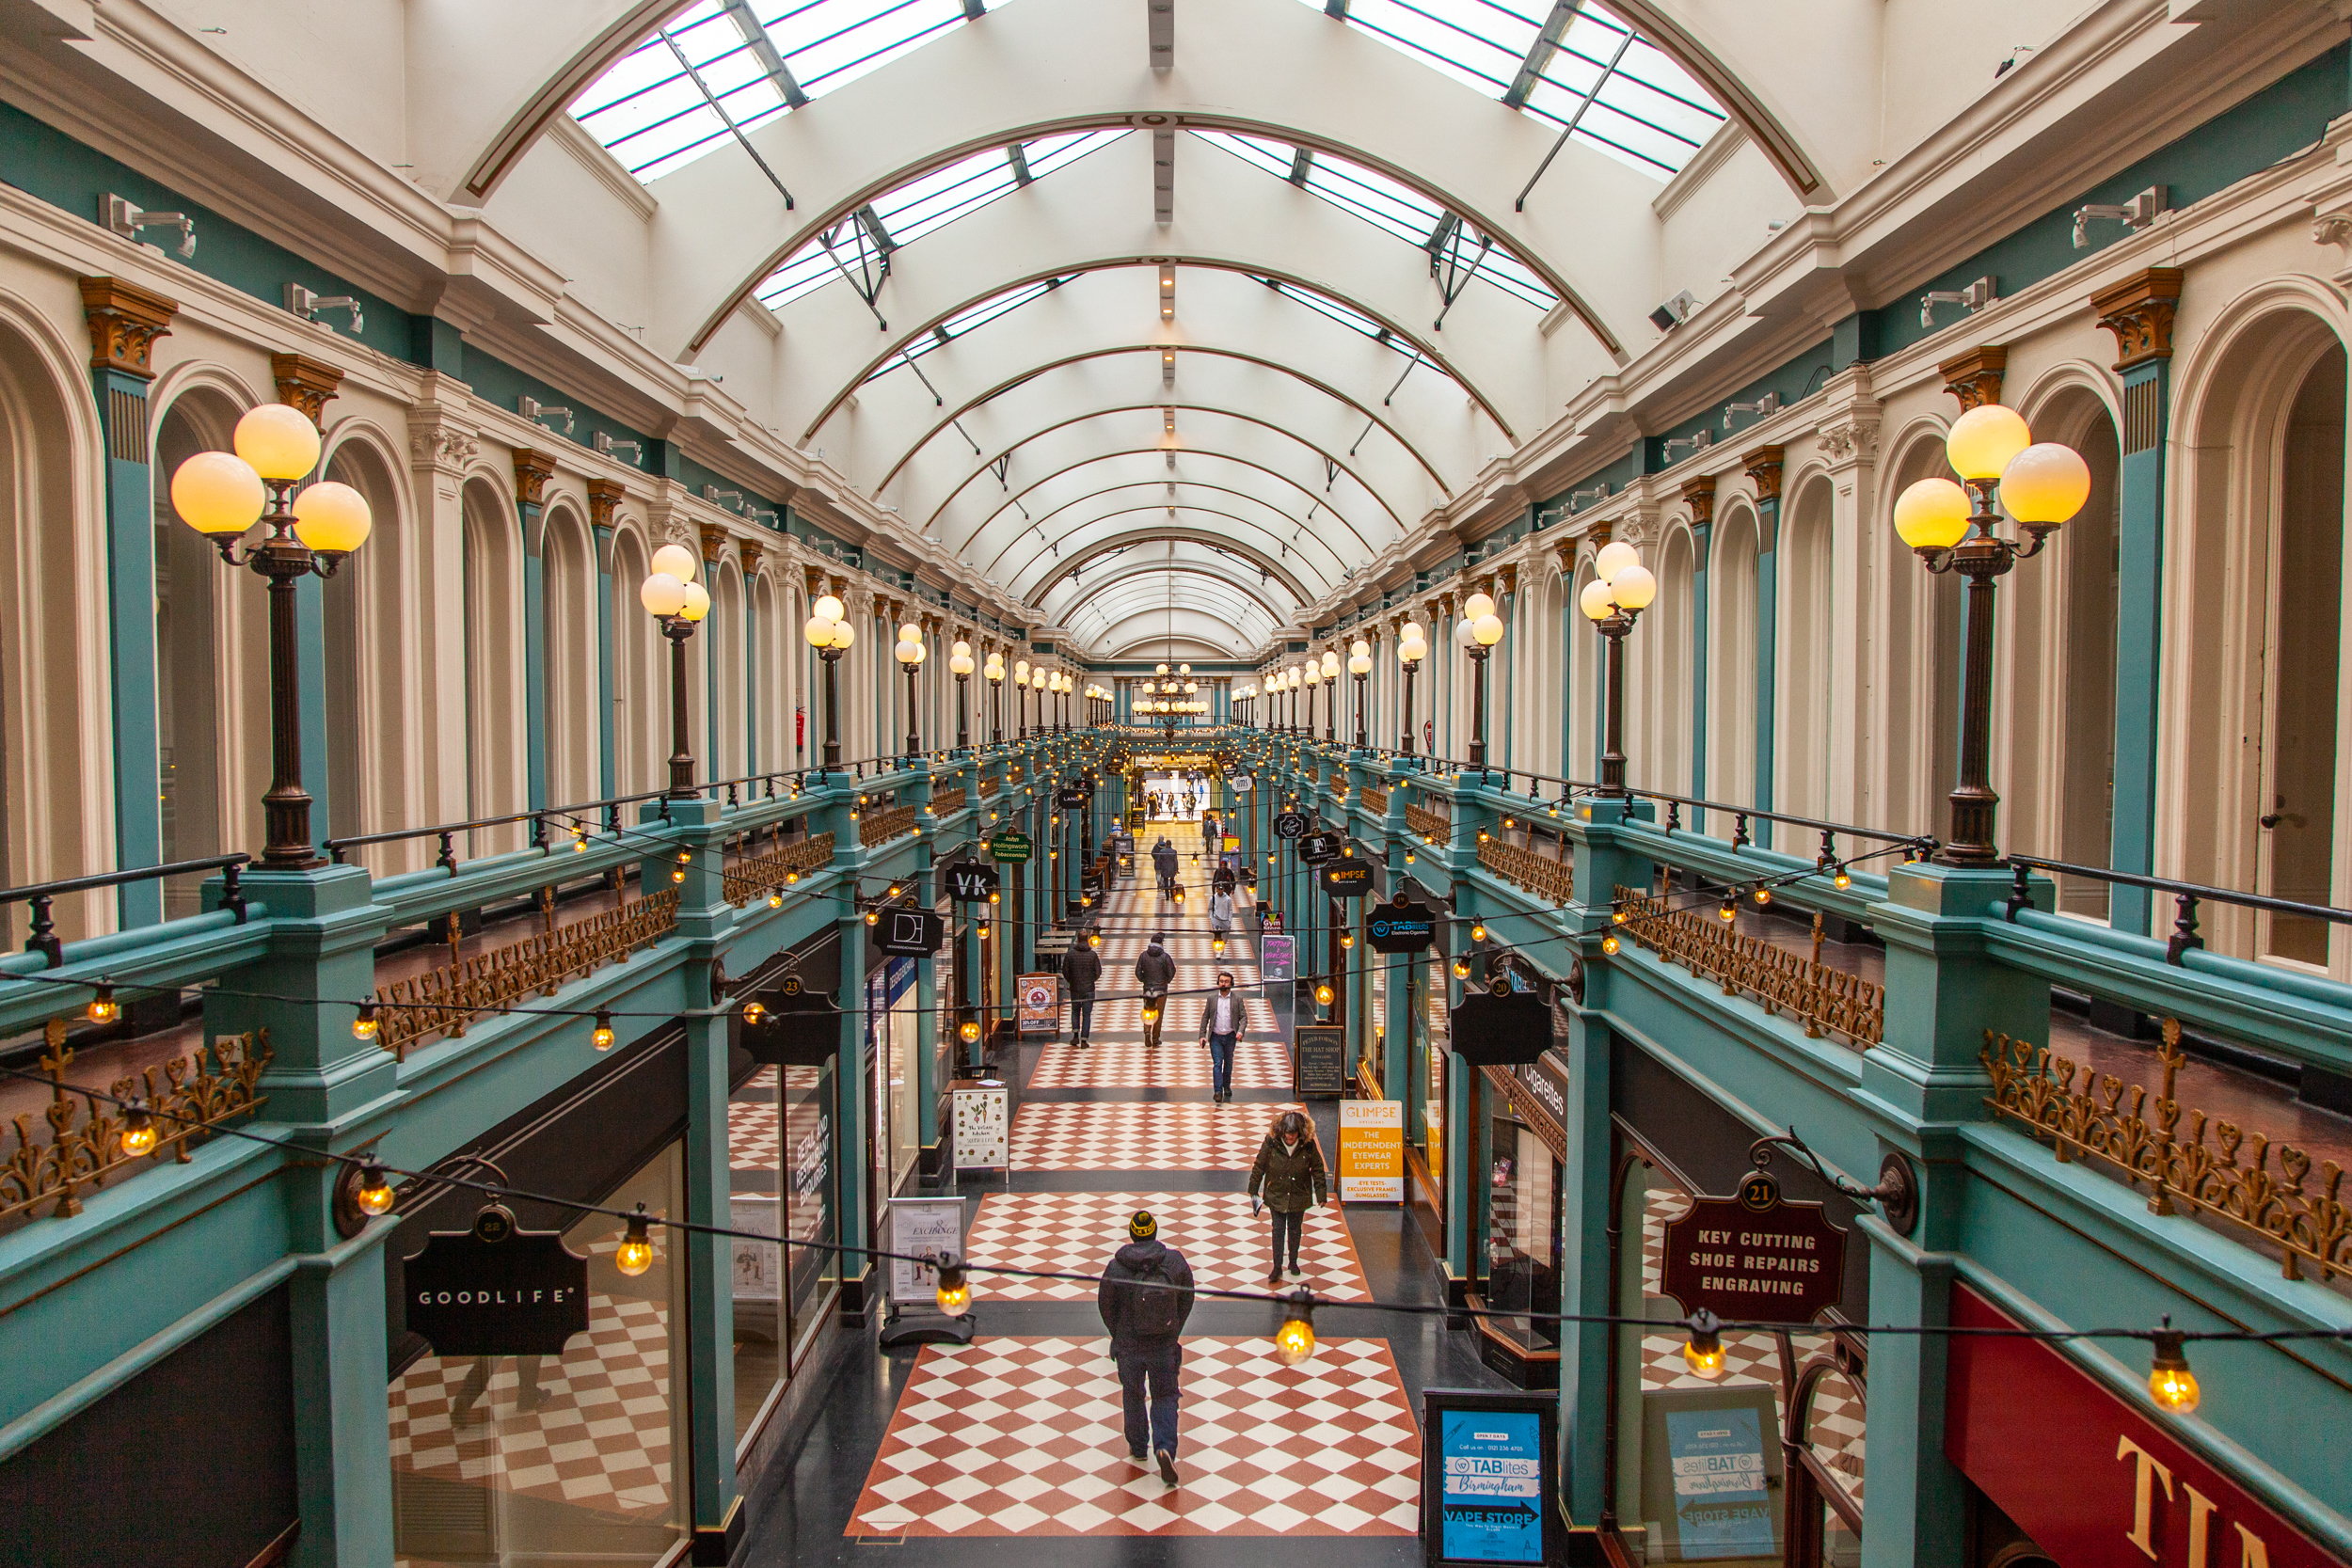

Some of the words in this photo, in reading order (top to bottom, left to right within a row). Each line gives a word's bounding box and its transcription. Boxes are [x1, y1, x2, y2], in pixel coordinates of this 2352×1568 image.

[993, 843, 1029, 851] Hollingsworth
[1329, 870, 1366, 879] IMPSE
[956, 872, 987, 896] VK
[786, 980, 798, 992] 23
[1495, 982, 1507, 993] 20
[1524, 1063, 1564, 1117] Cigarettes
[1345, 1106, 1397, 1118] GLIMPSE
[797, 1129, 816, 1164] RETAIL
[817, 1114, 829, 1137] AND
[1363, 1131, 1380, 1139] THE
[1343, 1141, 1401, 1149] INDEPENDENT
[796, 1132, 830, 1190] RESTAURANT
[1352, 1151, 1391, 1160] EYEWEAR
[1354, 1162, 1391, 1170] EXPERTS
[800, 1158, 828, 1208] ENQUIRIES
[1749, 1184, 1770, 1201] 21
[484, 1222, 501, 1232] 22
[1697, 1229, 1732, 1245] KEY
[1740, 1232, 1816, 1250] CUTTING
[1689, 1252, 1736, 1268] SHOE
[1743, 1255, 1820, 1274] REPAIRS
[1701, 1275, 1804, 1296] ENGRAVING
[1471, 1459, 1529, 1475] TABlites
[1459, 1475, 1525, 1496] Birmingham
[1444, 1511, 1483, 1523] VAPE
[1486, 1513, 1534, 1525] STORE
